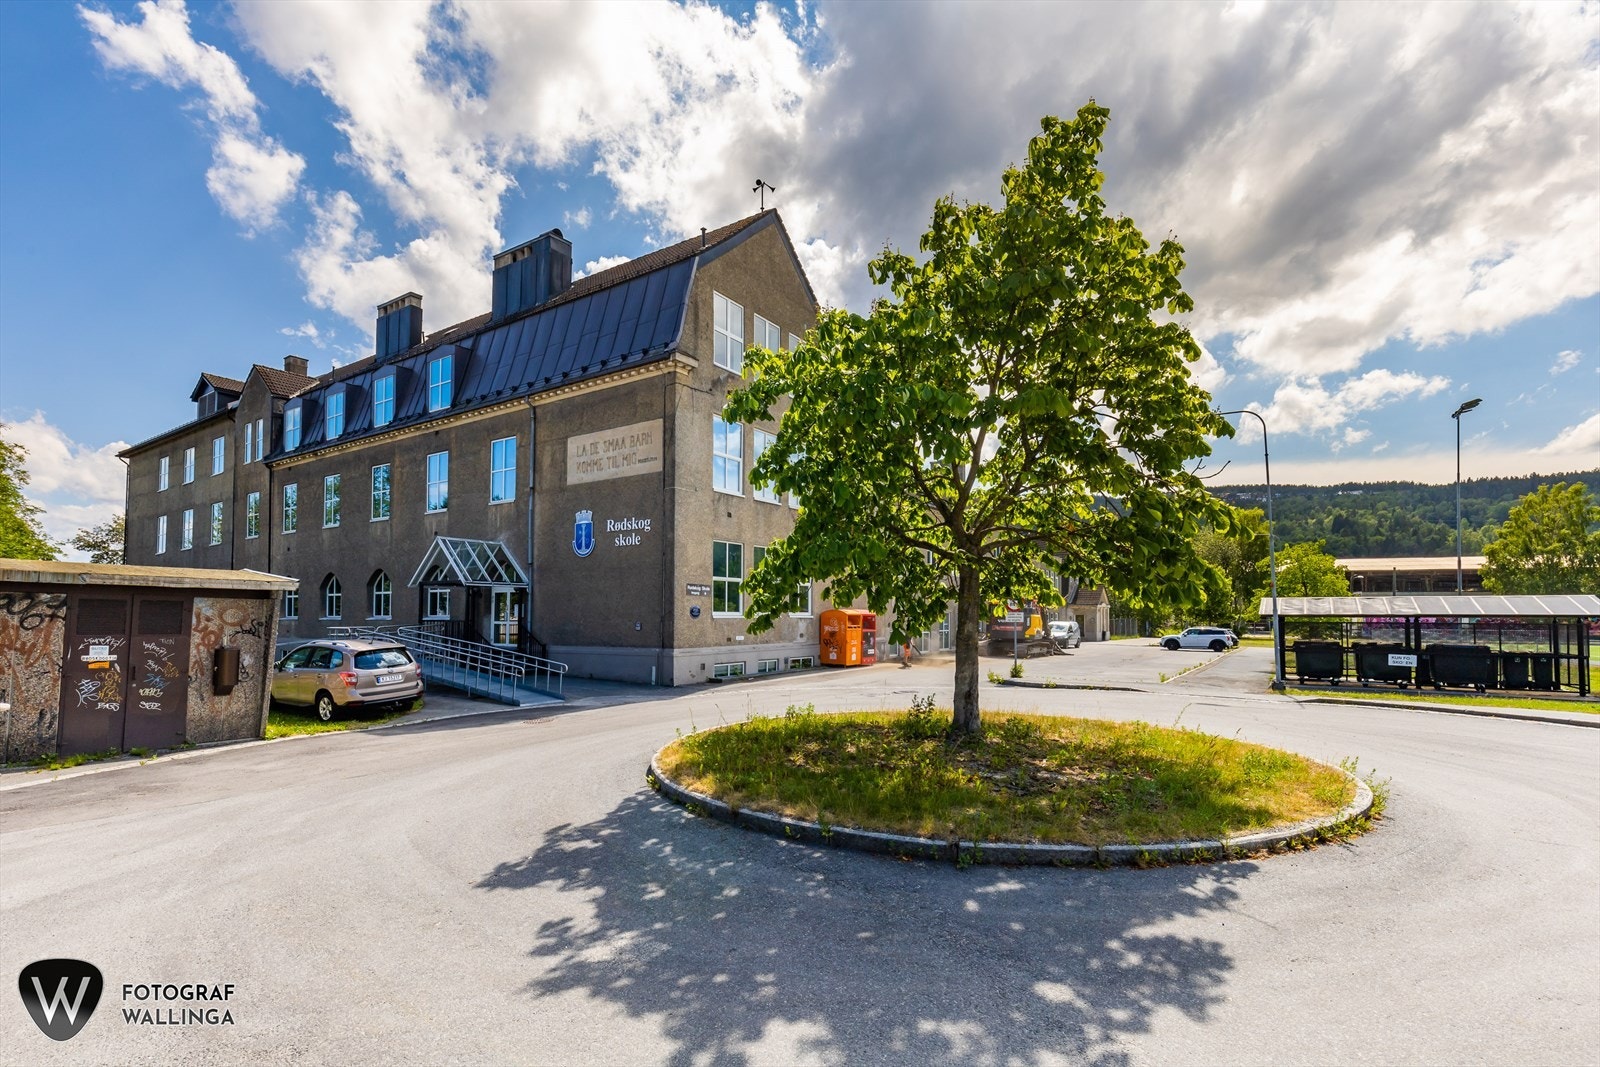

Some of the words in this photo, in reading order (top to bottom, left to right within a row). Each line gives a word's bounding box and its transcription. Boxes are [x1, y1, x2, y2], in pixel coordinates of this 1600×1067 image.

[576, 444, 587, 457] LA
[590, 442, 600, 455] DE
[603, 435, 626, 454] SMAA
[629, 431, 653, 448] BARN
[576, 456, 604, 474] KOMME
[606, 454, 620, 470] TIL
[622, 452, 637, 468] MIG
[606, 517, 651, 533] Rødskog
[614, 533, 641, 547] skole
